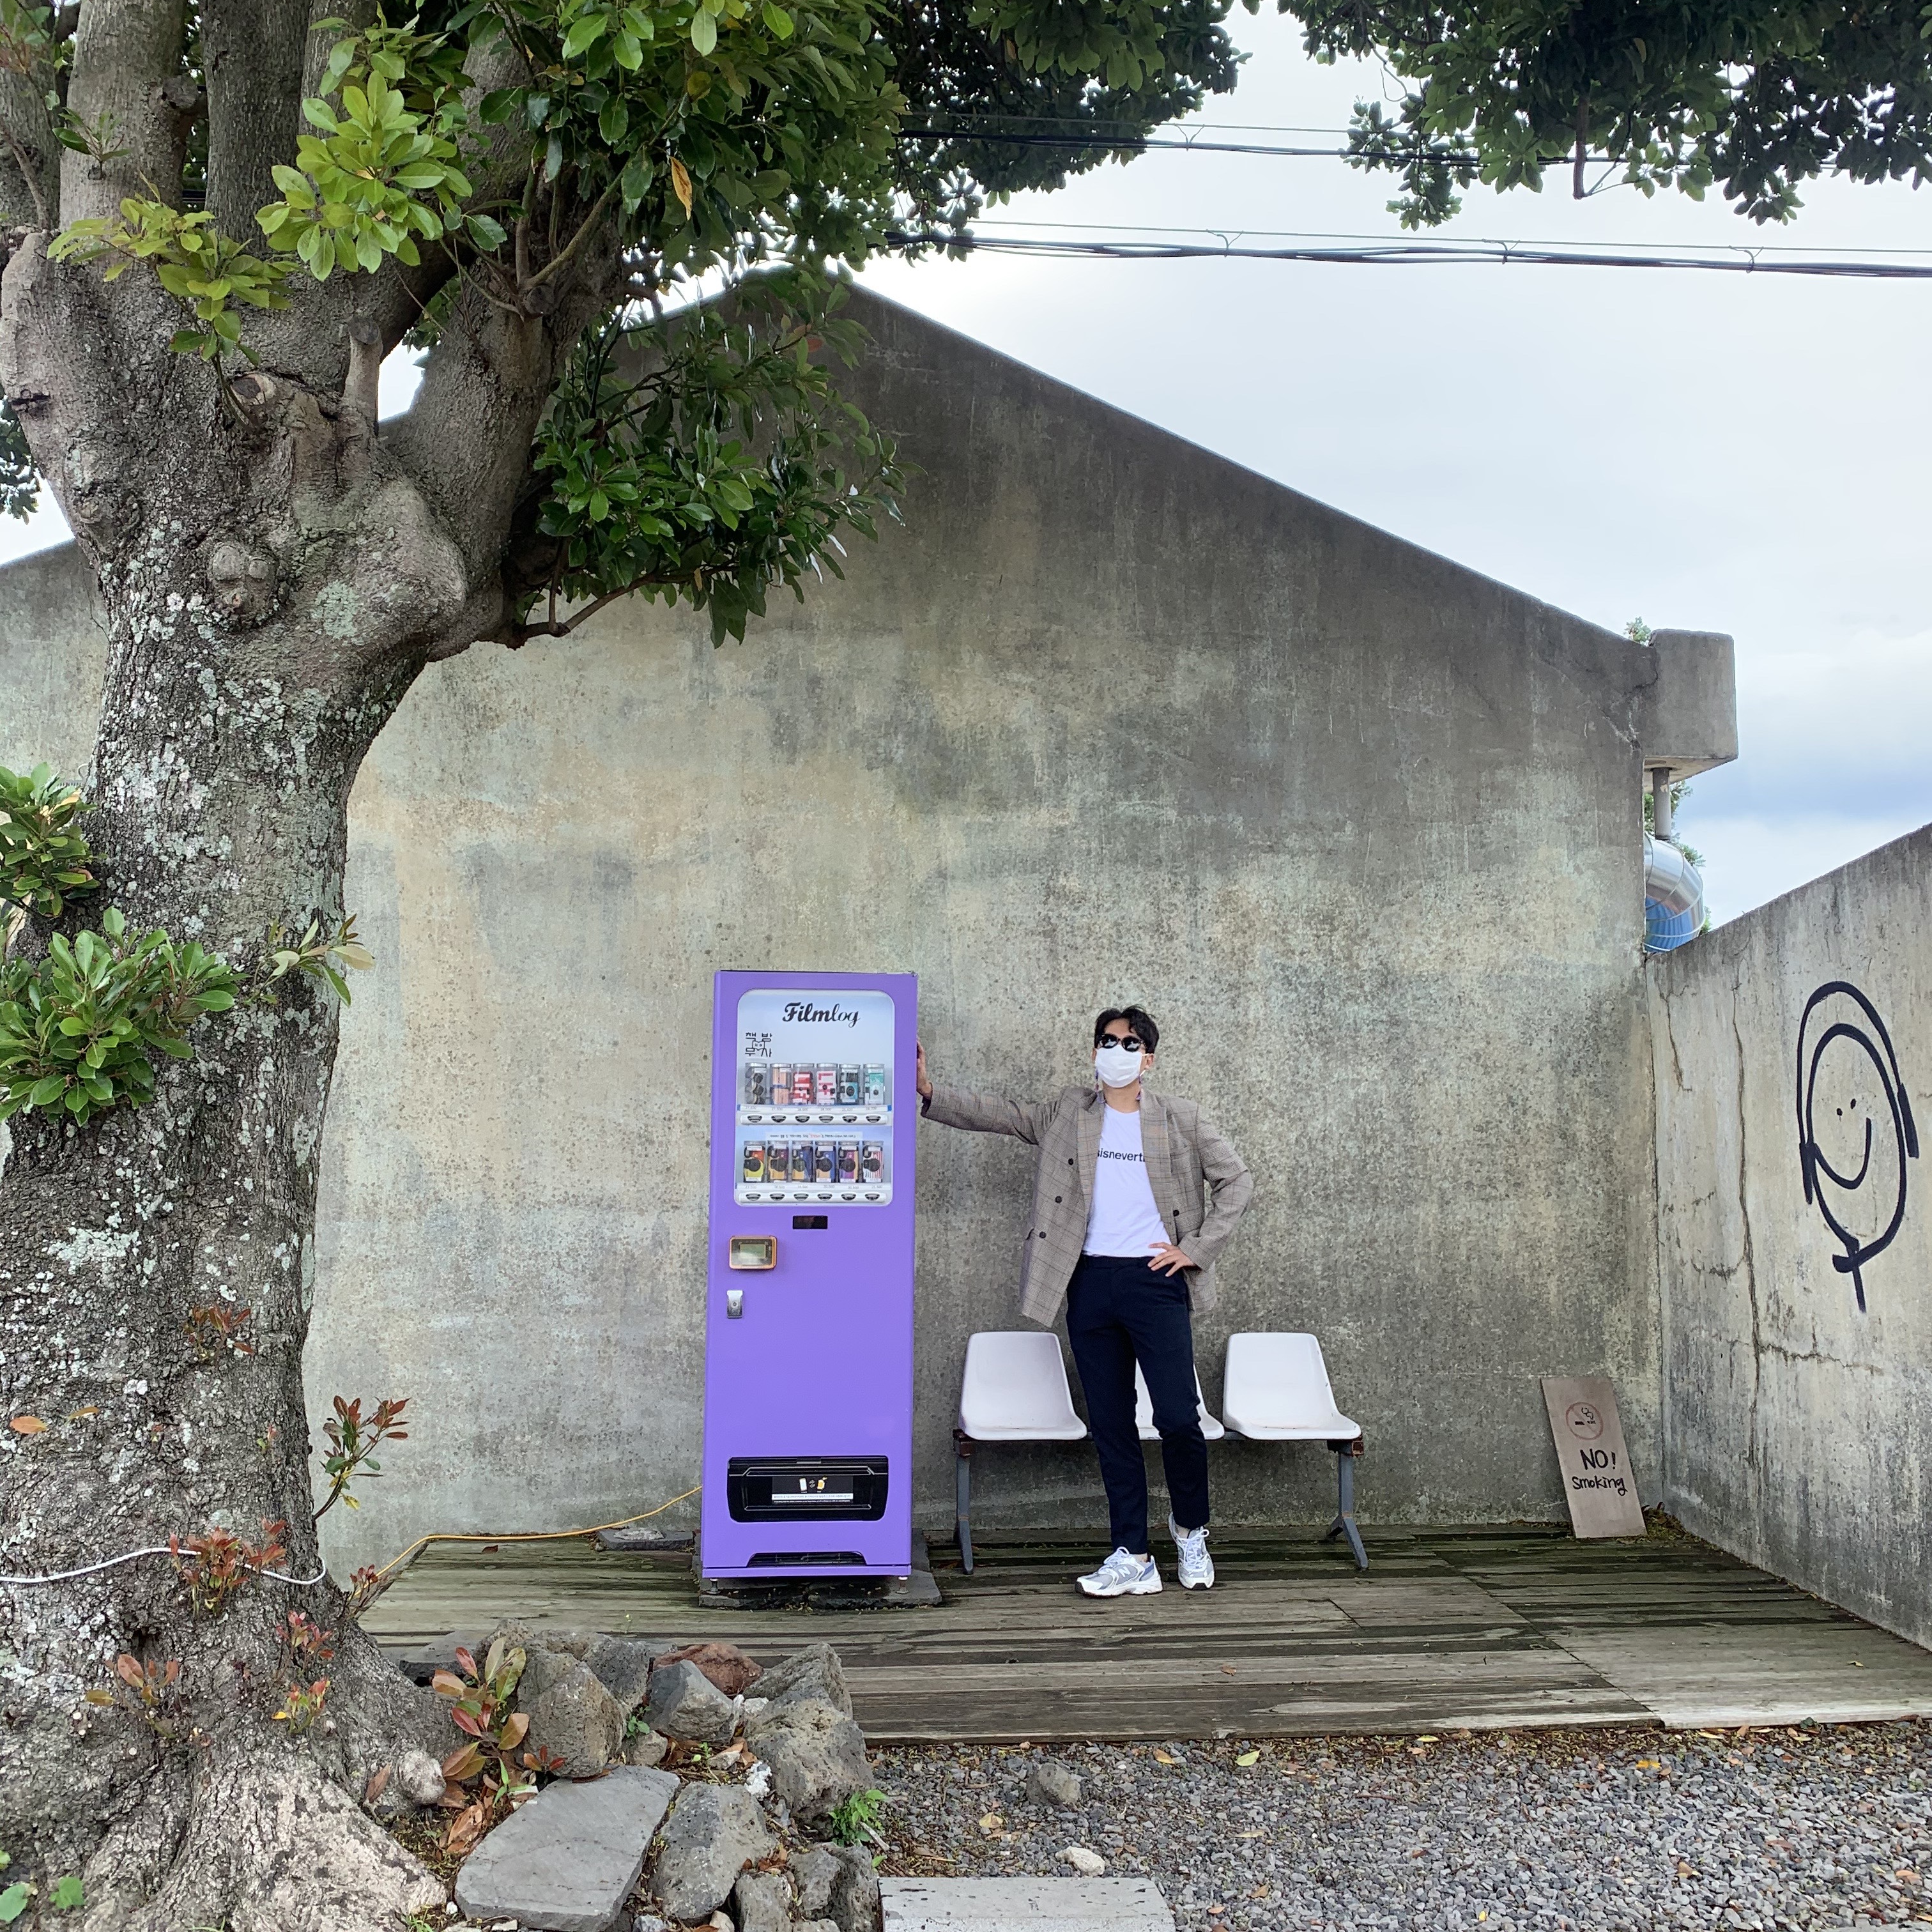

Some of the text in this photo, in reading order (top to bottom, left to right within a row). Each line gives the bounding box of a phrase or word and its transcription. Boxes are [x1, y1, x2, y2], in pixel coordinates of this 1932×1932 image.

[782, 1002, 861, 1027] Filmlog
[1580, 1448, 1616, 1469] NO!
[1118, 1567, 1130, 1577] N
